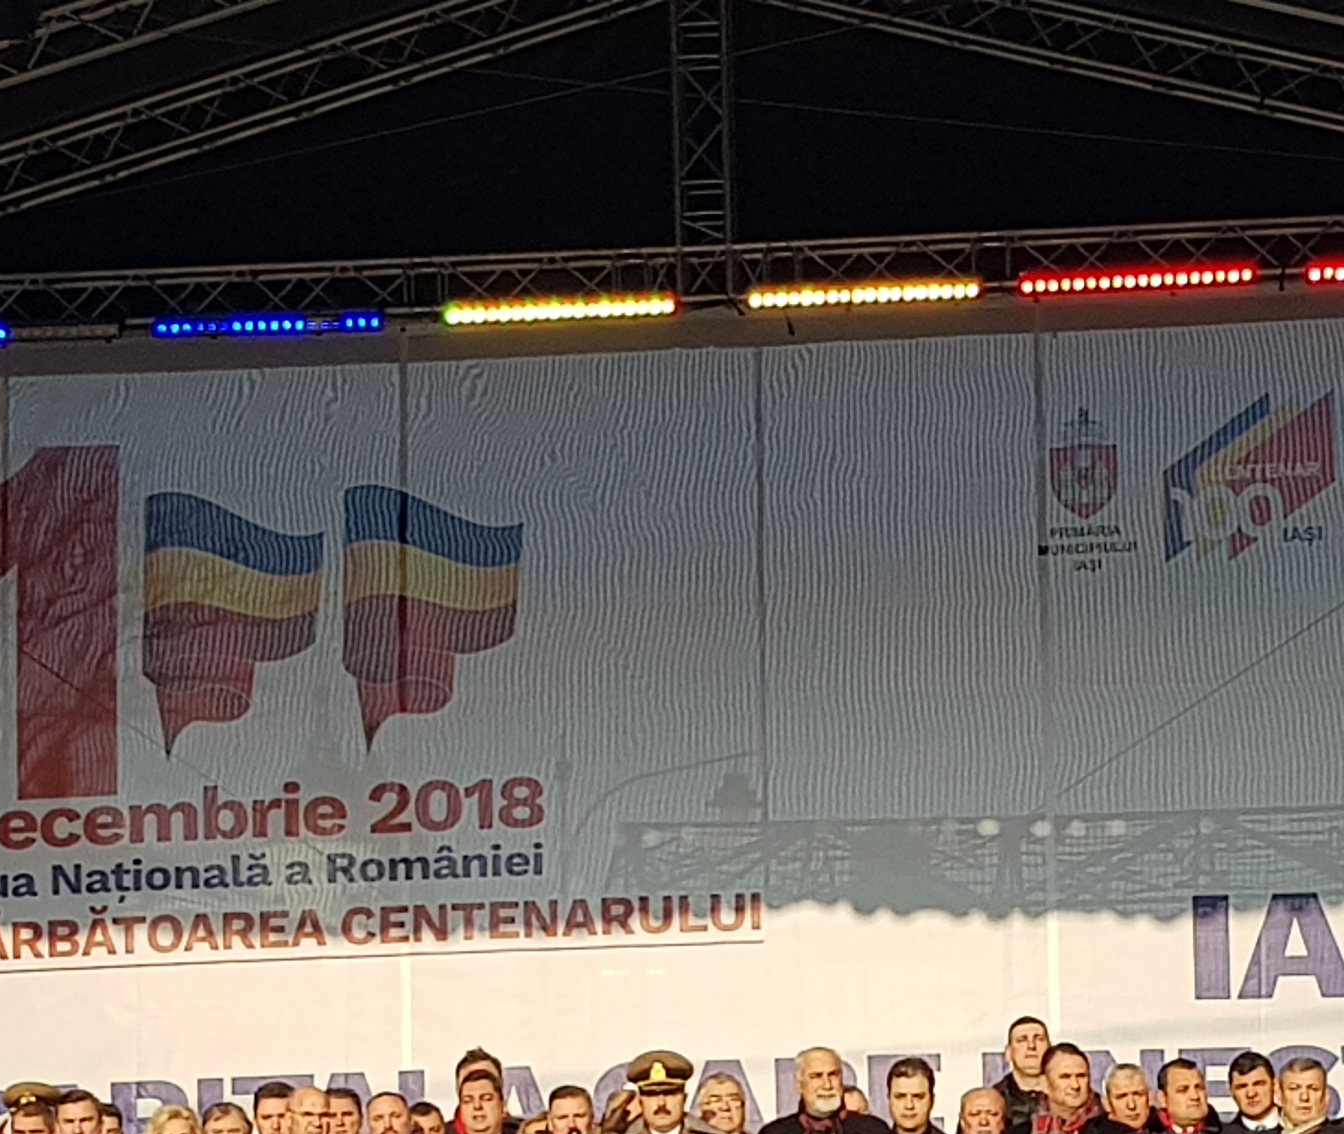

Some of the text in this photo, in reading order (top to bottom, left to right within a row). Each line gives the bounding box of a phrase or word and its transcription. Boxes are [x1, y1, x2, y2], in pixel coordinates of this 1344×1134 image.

[368, 776, 546, 834] 2018
[51, 852, 274, 904] Națională
[285, 860, 313, 886] a
[327, 842, 545, 884] României
[341, 892, 763, 946] CENTENARULUI
